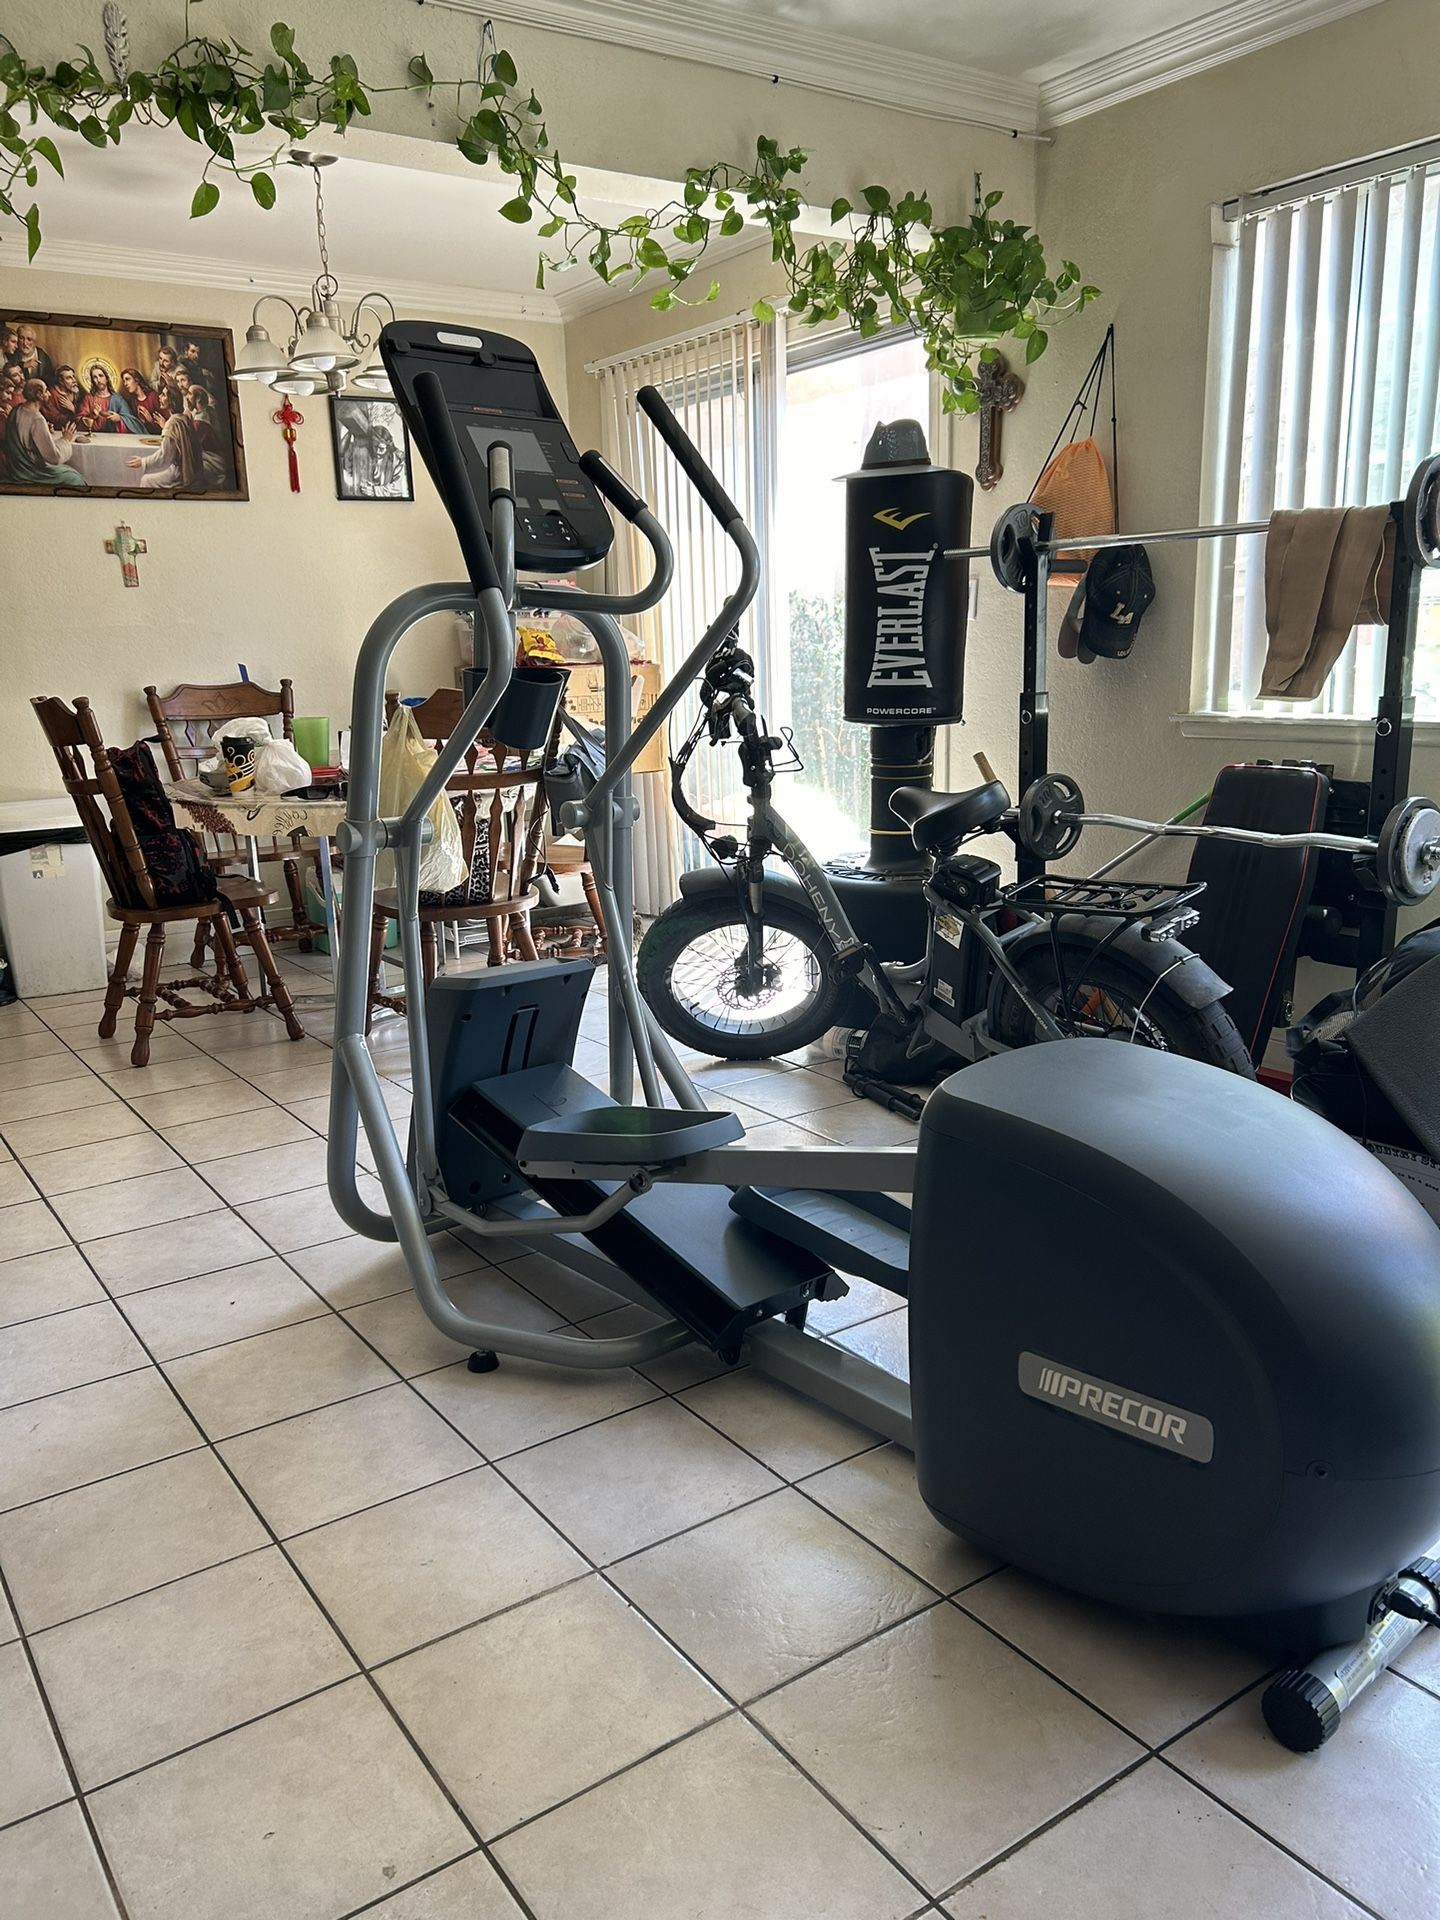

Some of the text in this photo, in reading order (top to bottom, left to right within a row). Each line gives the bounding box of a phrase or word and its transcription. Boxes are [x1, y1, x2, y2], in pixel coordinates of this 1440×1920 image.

[866, 547, 936, 688] EVERLAST
[1109, 602, 1135, 625] LA
[866, 706, 934, 716] POWERCORE
[783, 843, 840, 939] DOHENY
[1058, 1375, 1188, 1445] PRECOR
